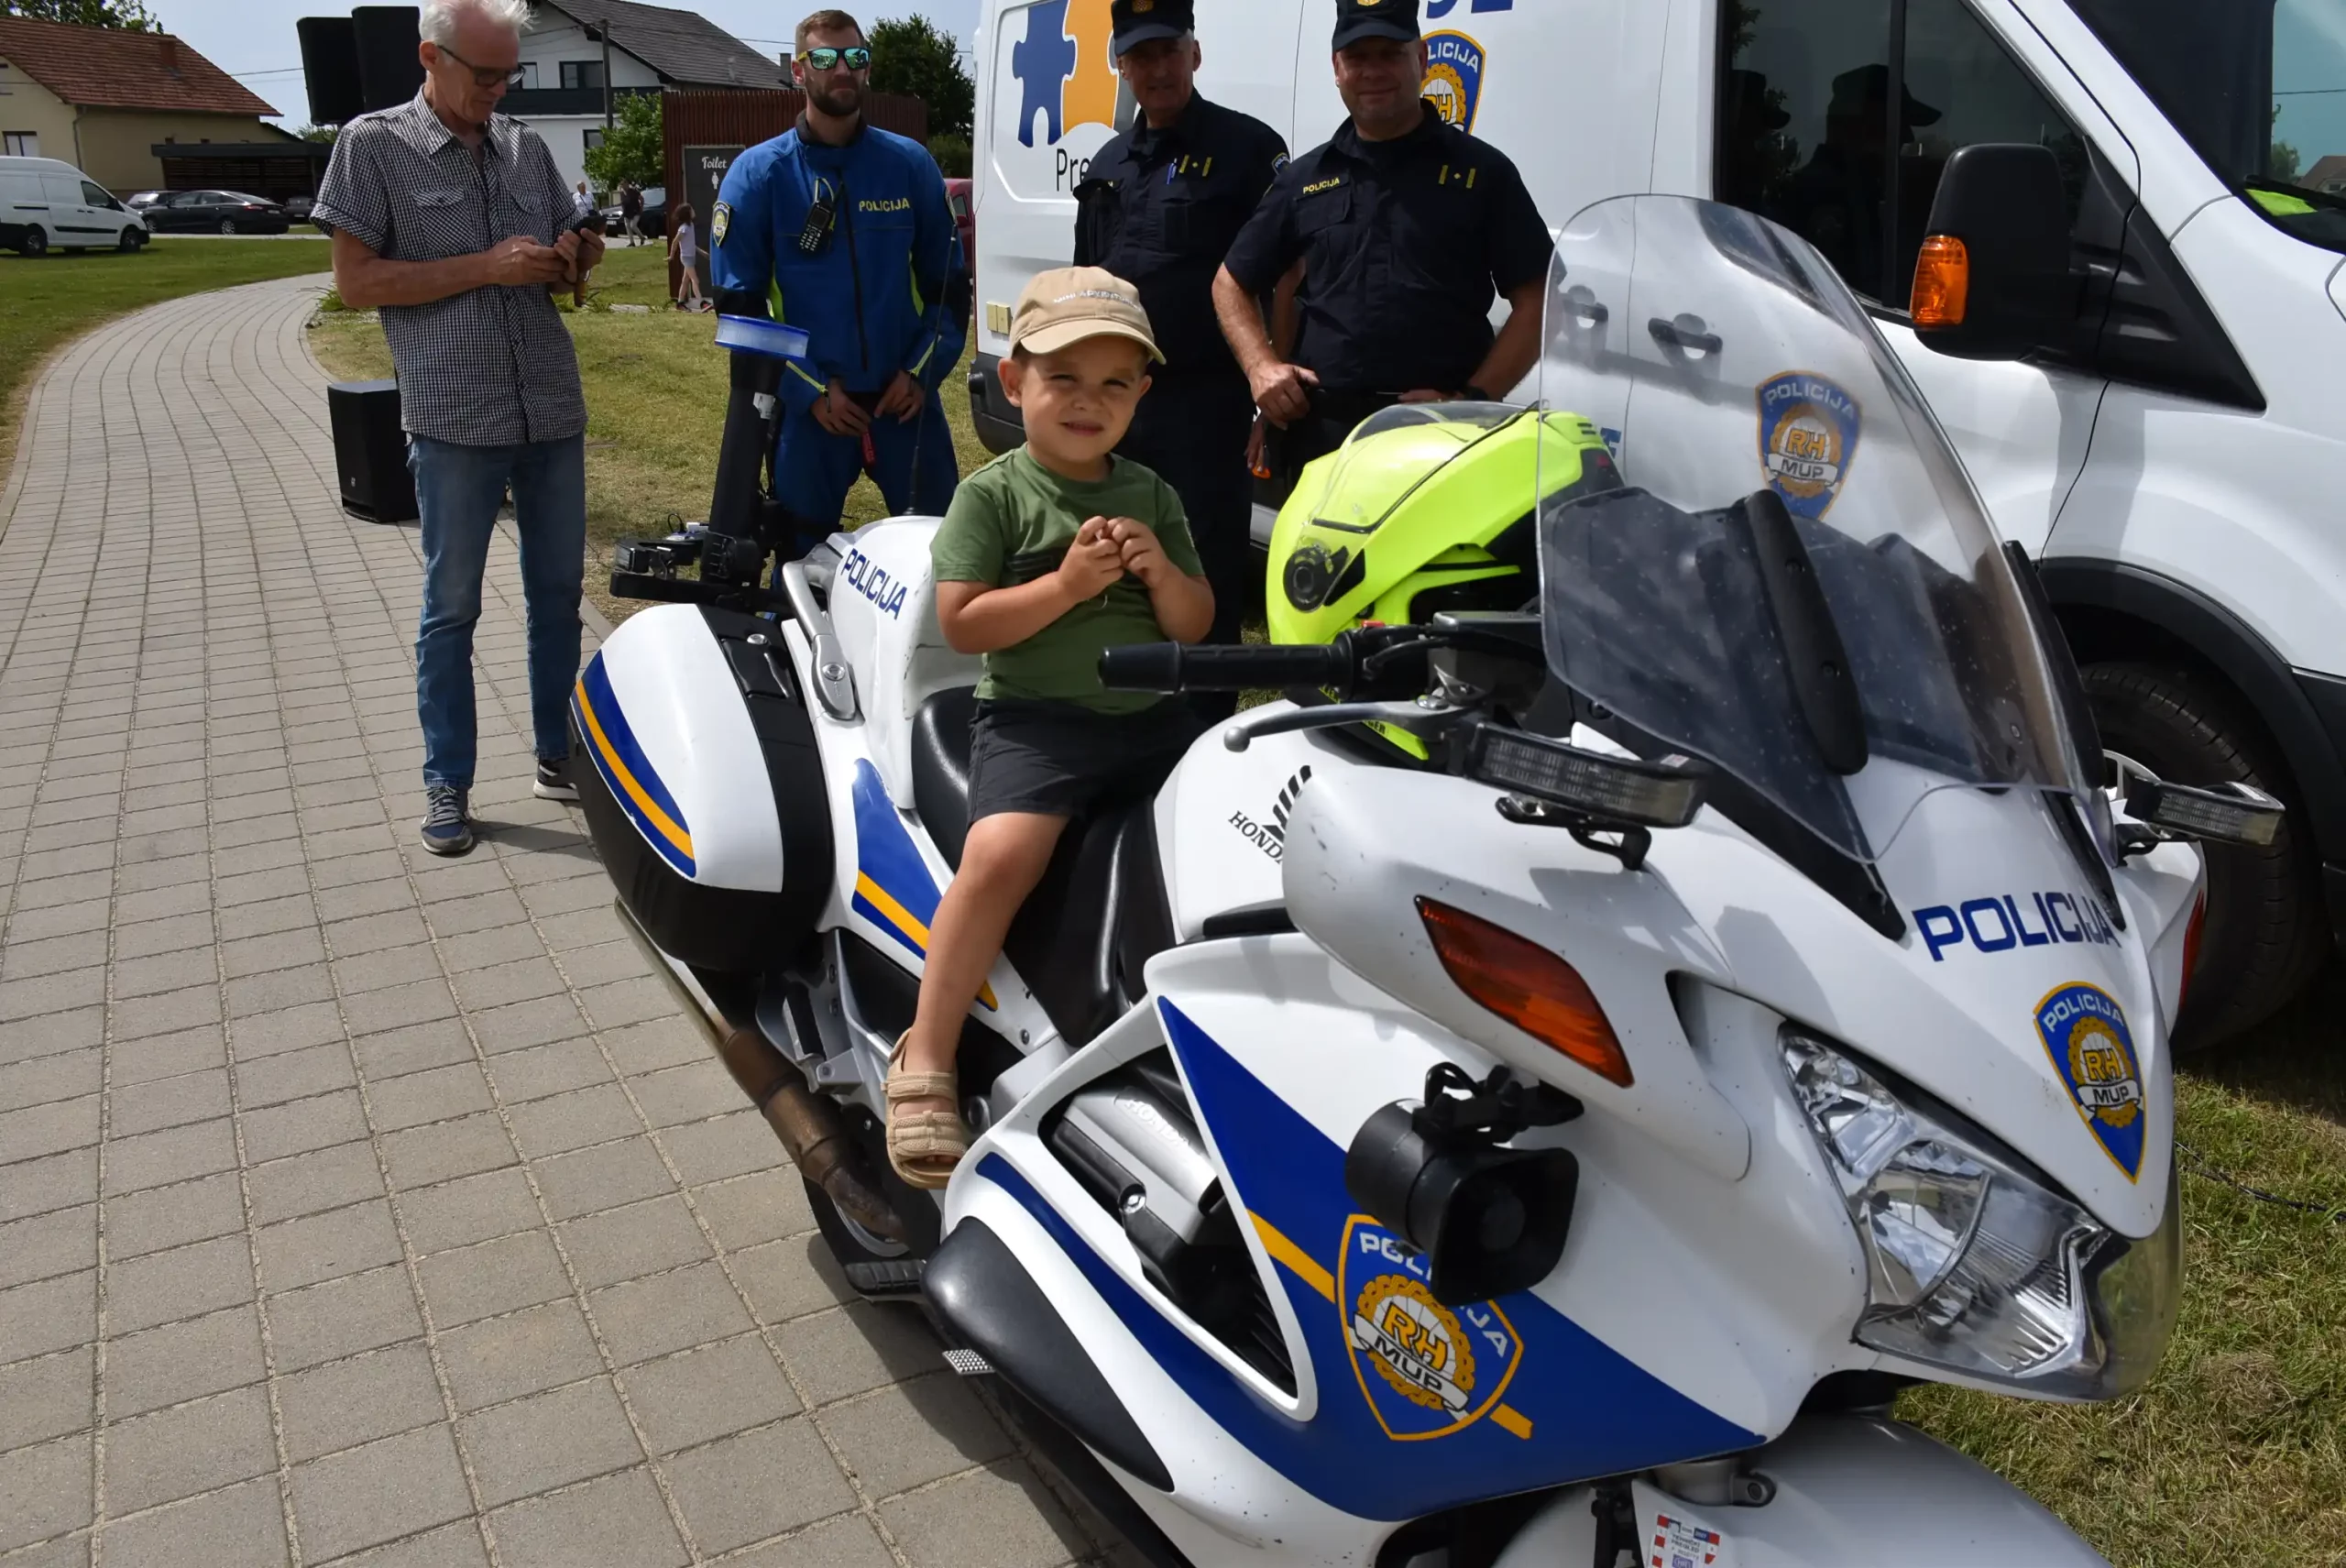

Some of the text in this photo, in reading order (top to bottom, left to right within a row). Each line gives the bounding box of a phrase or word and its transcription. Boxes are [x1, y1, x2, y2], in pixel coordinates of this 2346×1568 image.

[1428, 42, 1479, 73] LICIJA
[701, 156, 728, 170] Toilet
[1057, 148, 1091, 192] Pre
[859, 197, 910, 212] POLICIJA
[1302, 177, 1340, 194] POLICIJA
[1765, 381, 1856, 420] POLICIJA
[1786, 428, 1826, 461] RH
[1781, 459, 1825, 478] MUP
[840, 548, 908, 620] POLICIJA
[1228, 810, 1283, 864] HOND
[1912, 892, 2122, 962] POLICIJA
[2043, 993, 2124, 1033] POLICIJA
[2082, 1048, 2122, 1082] RH
[2092, 1086, 2129, 1104] MUP
[1360, 1232, 1507, 1358] POLJA
[1382, 1301, 1448, 1372] RH
[1375, 1335, 1442, 1391] MUP
